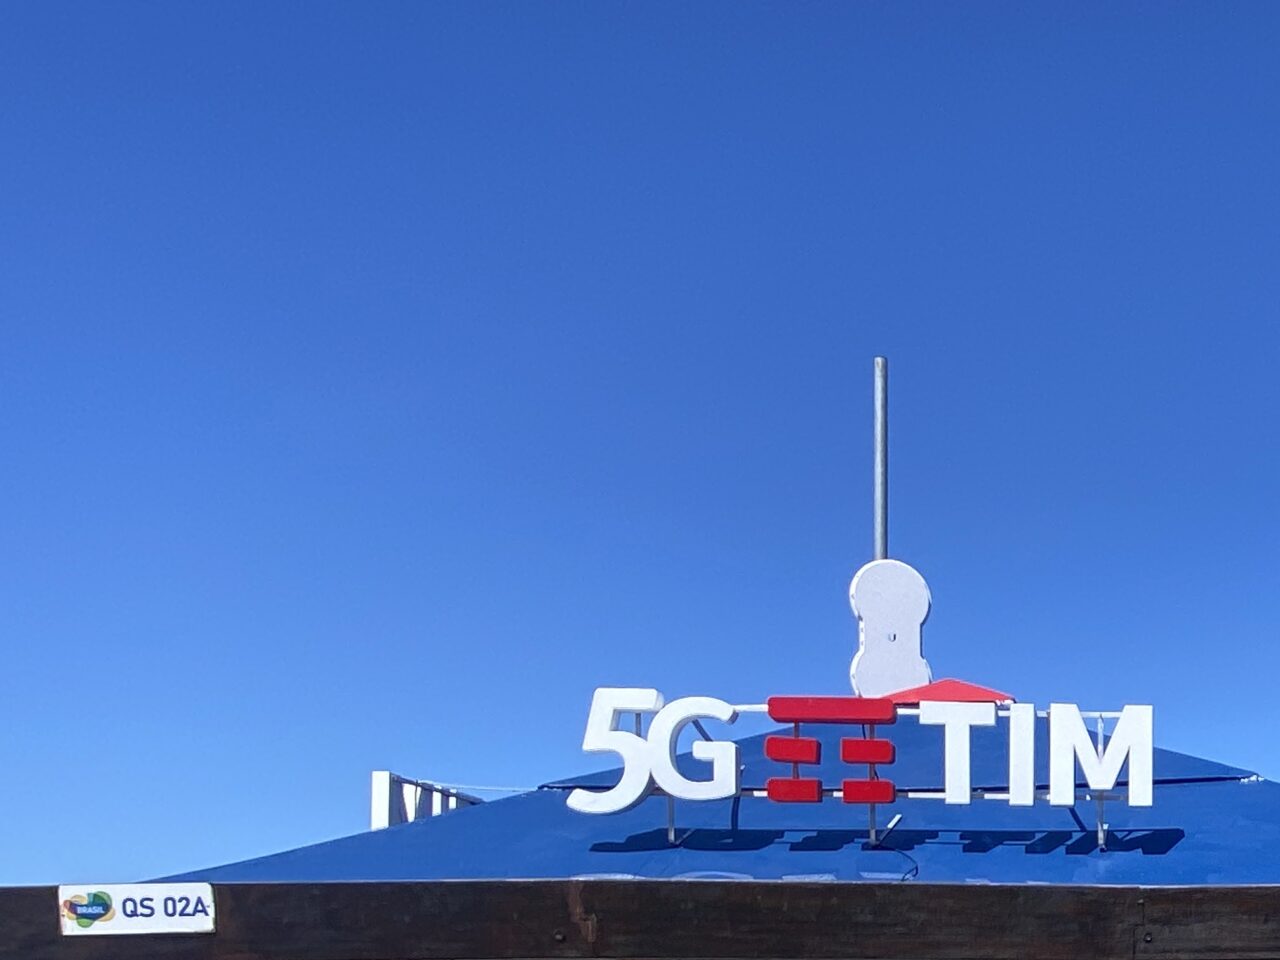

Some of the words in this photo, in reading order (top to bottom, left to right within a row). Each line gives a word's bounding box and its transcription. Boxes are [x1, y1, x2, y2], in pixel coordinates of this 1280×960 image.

[569, 687, 741, 814] 5G
[919, 701, 1154, 807] TIM
[122, 897, 156, 918] QS
[163, 896, 210, 917] 02A
